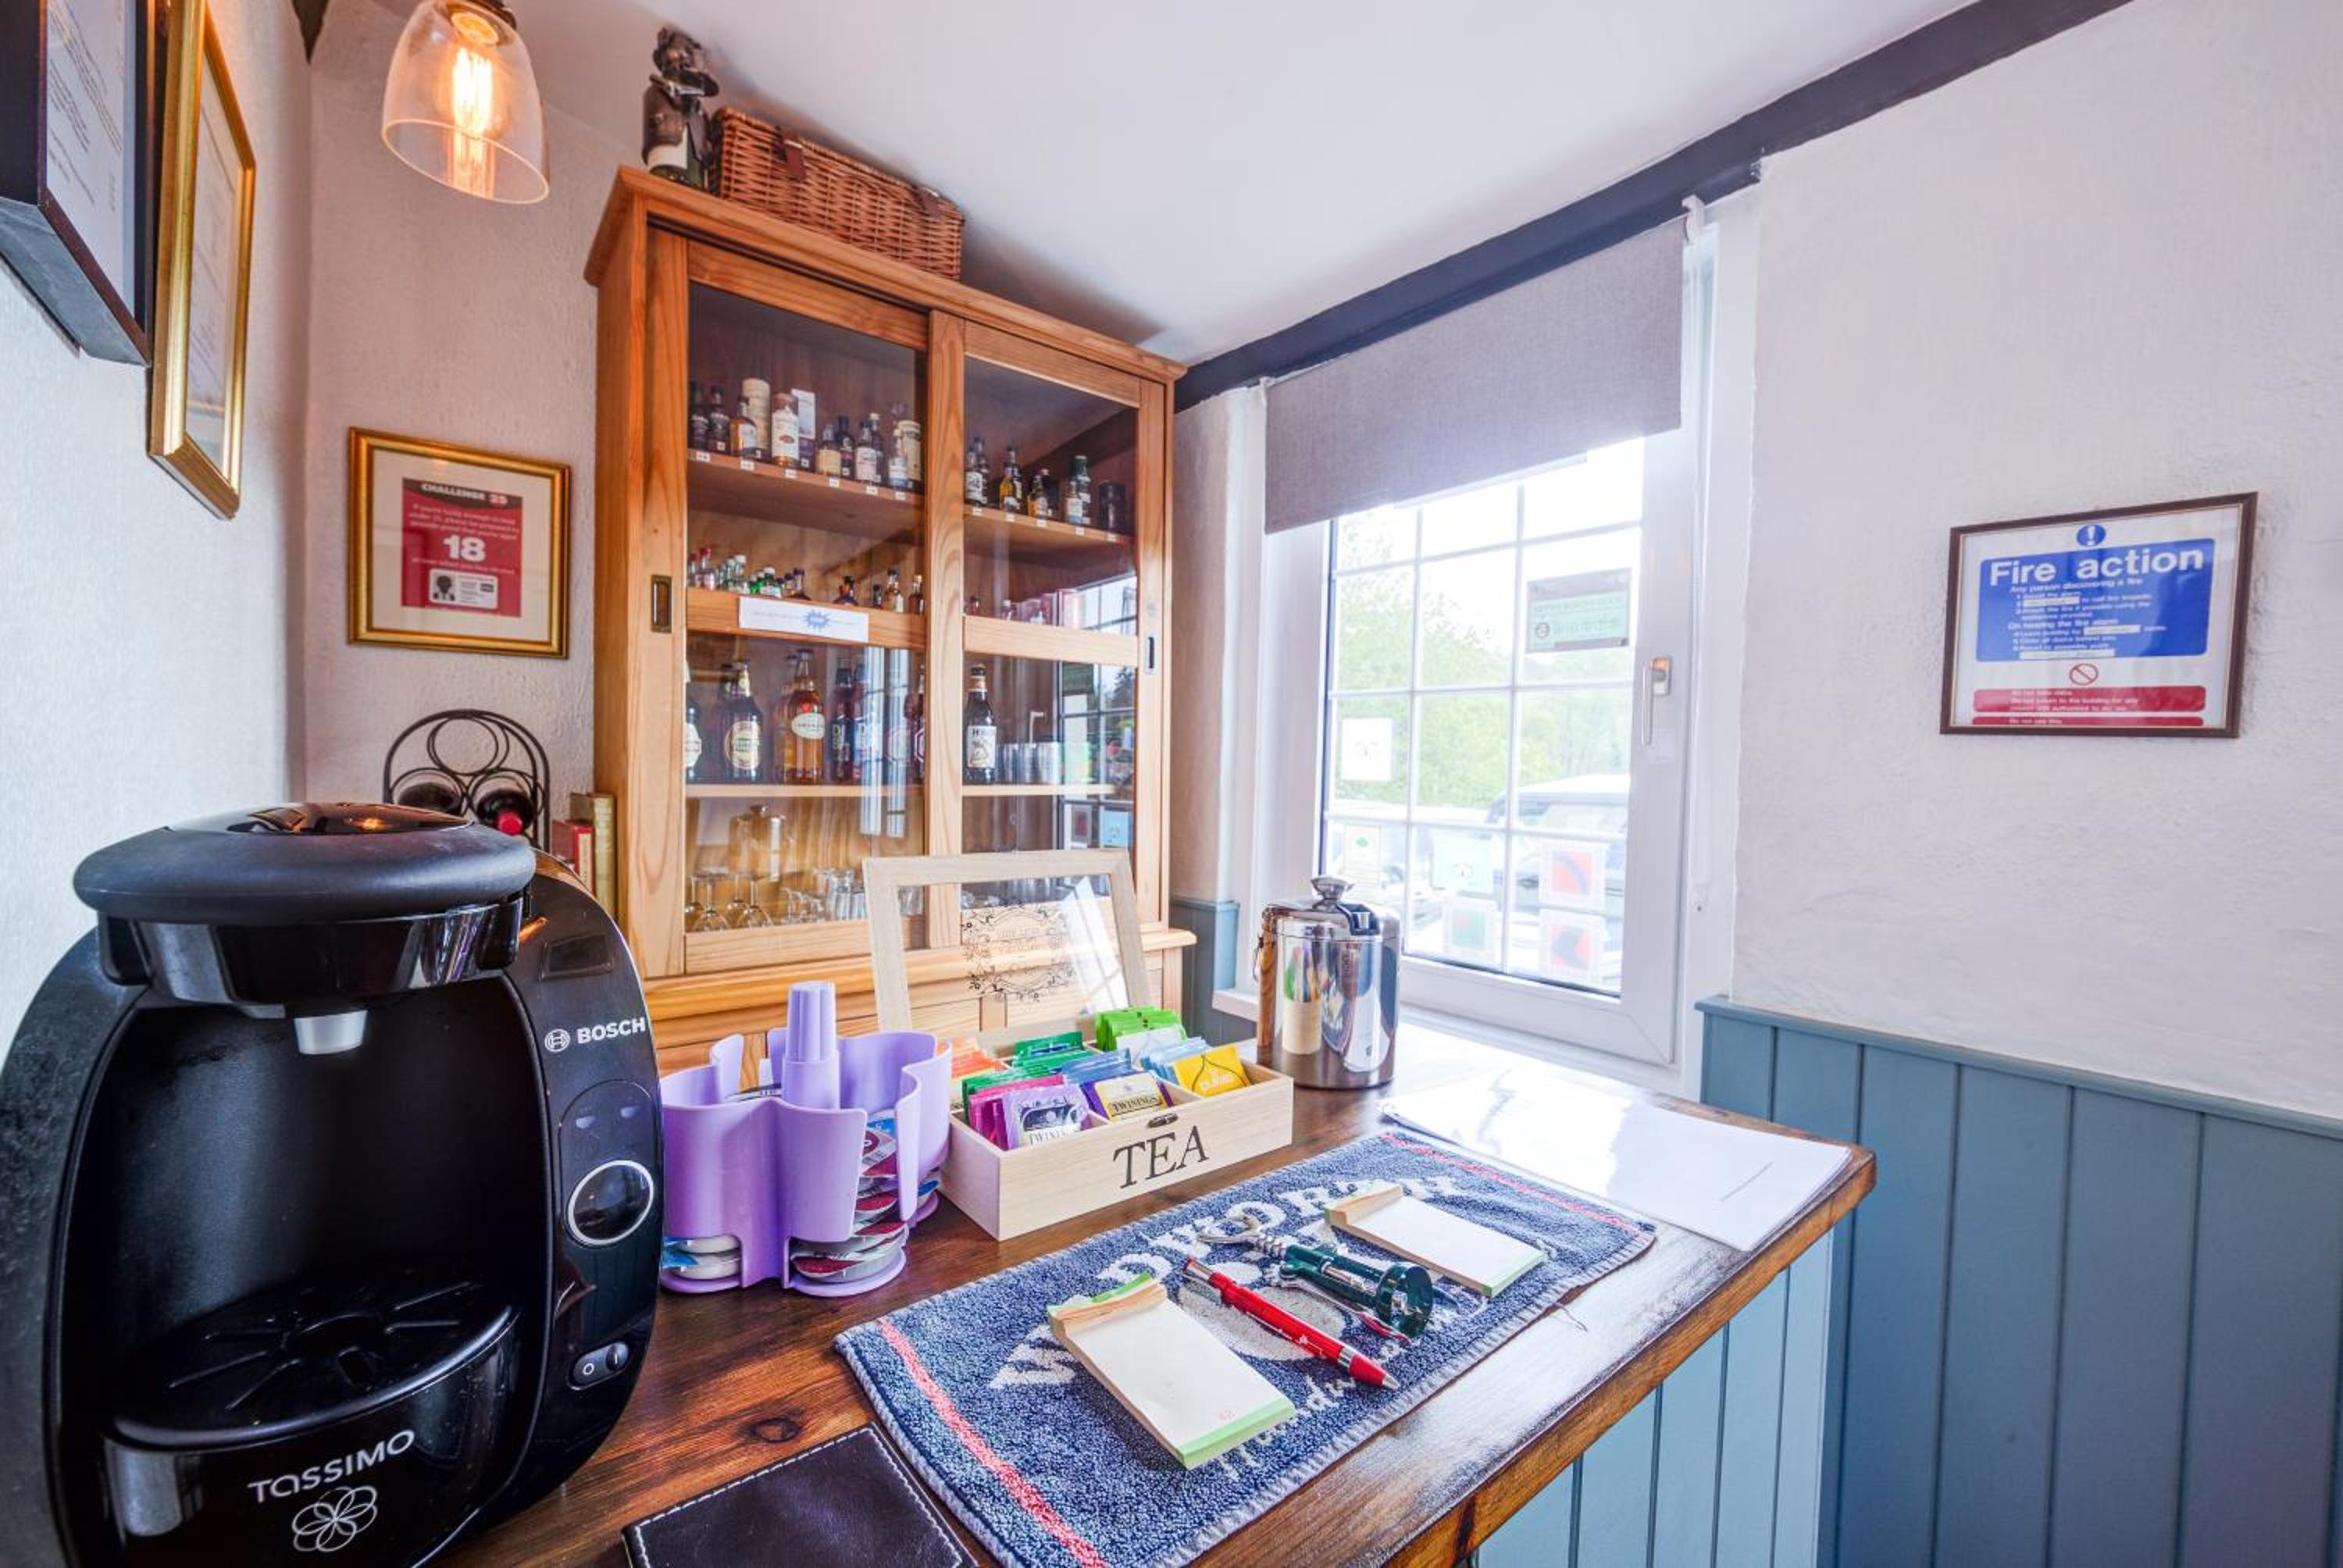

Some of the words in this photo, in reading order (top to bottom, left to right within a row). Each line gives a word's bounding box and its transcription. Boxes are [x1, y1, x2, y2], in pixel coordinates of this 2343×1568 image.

[421, 483, 486, 501] CHALLENGE
[443, 534, 486, 562] 18
[1991, 559, 2056, 586] Fire
[2076, 548, 2203, 579] action
[576, 1017, 646, 1044] BOSCH
[1112, 1095, 1157, 1113] TWININGS
[1113, 1125, 1210, 1188] TEA
[247, 1430, 415, 1503] TASSIMO
